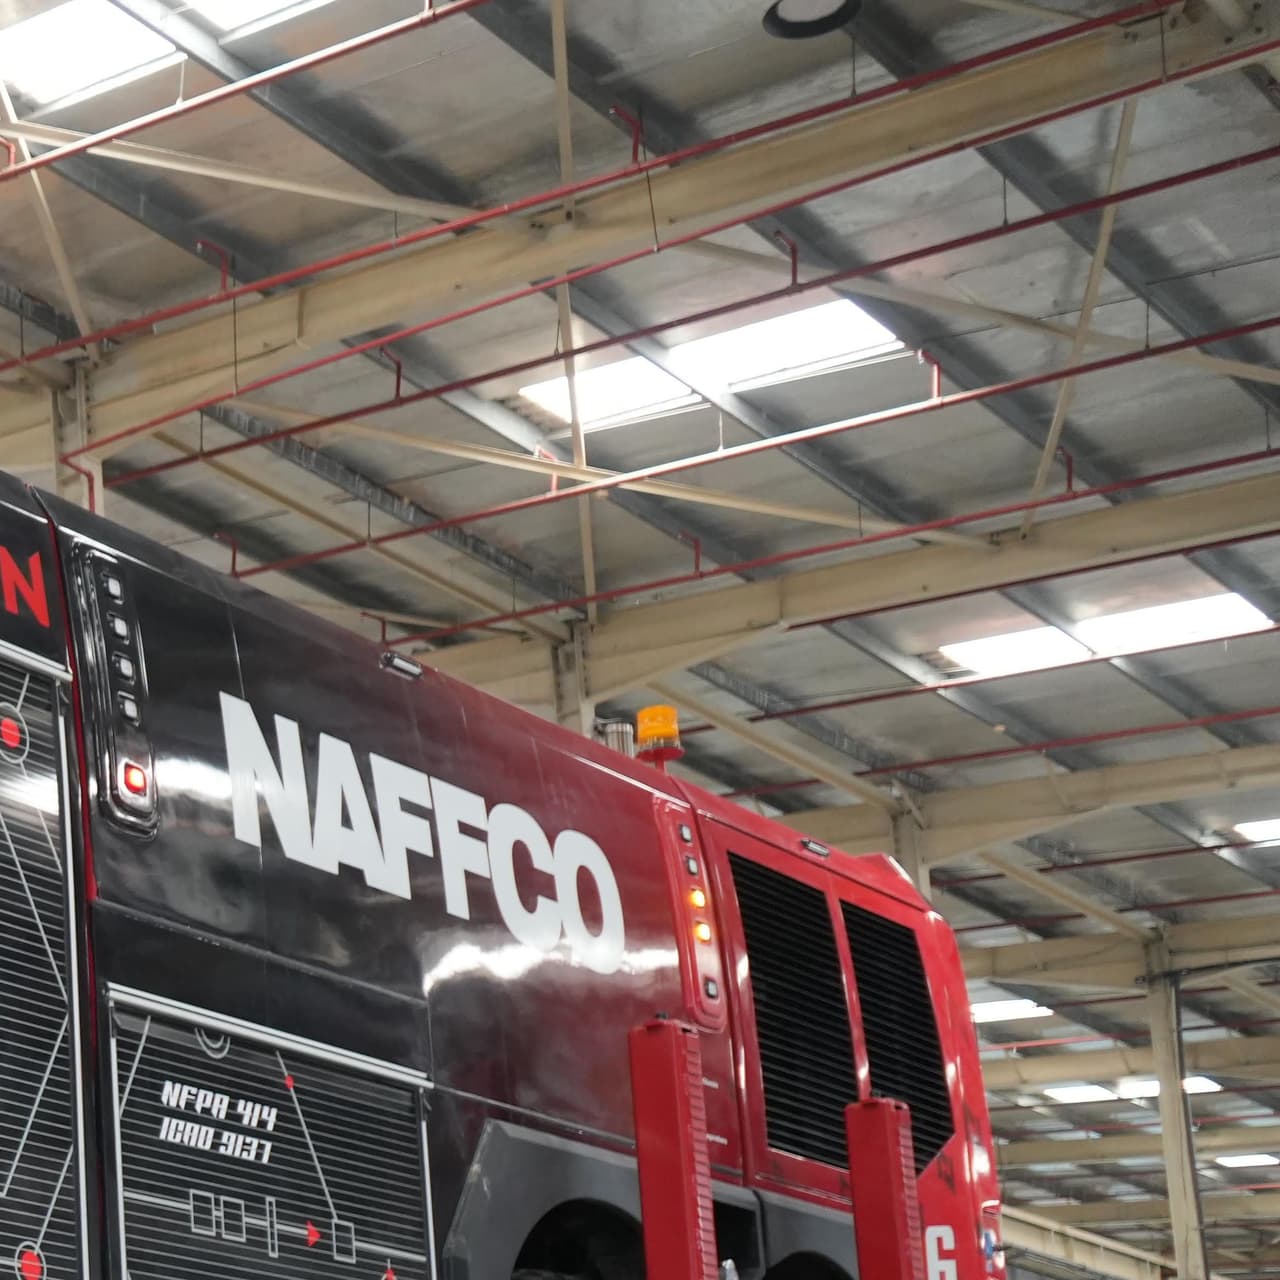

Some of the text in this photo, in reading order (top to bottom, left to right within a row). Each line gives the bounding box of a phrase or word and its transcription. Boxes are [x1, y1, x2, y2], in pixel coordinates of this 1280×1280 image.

[219, 691, 626, 974] NAFFCO
[161, 1080, 278, 1132] NFPA 414
[159, 1116, 273, 1164] ICAO 9137
